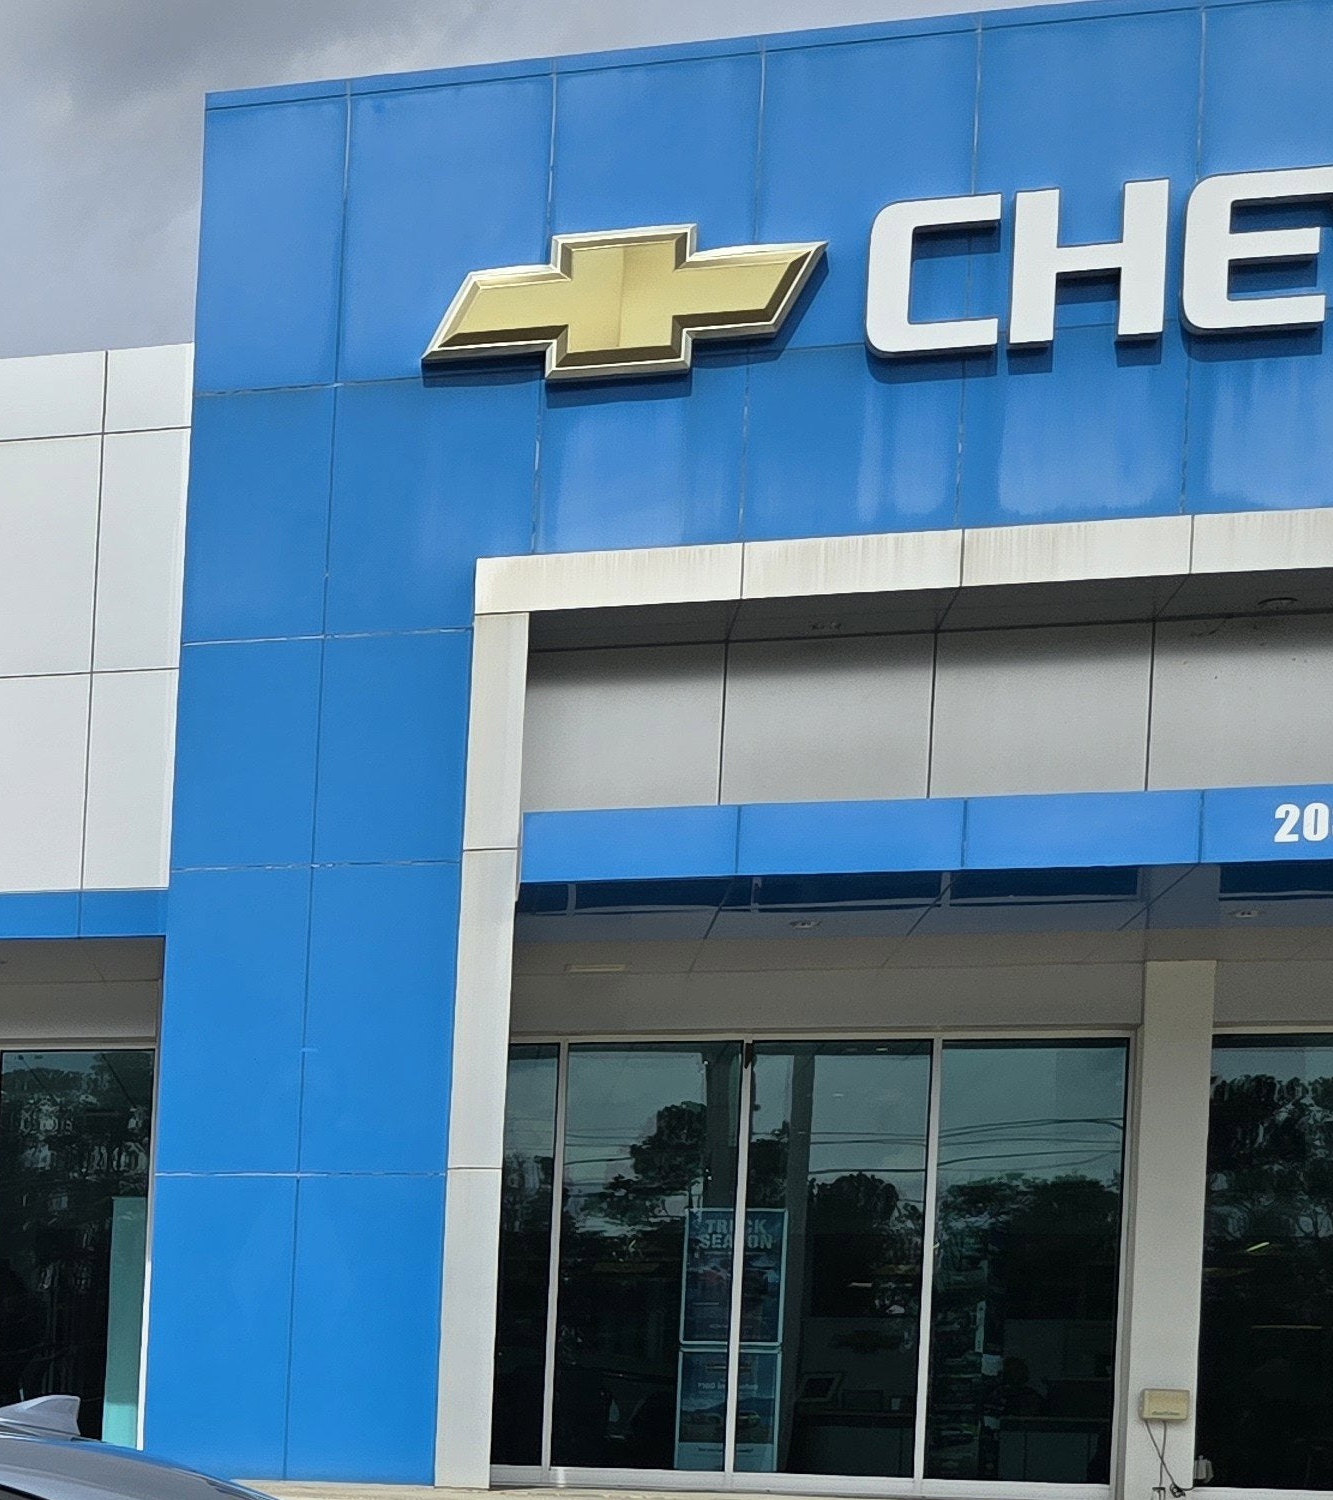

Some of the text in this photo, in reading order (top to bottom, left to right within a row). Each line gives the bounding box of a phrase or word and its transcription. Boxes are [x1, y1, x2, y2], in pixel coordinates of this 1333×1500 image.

[864, 165, 1333, 360] CHE
[1274, 802, 1333, 843] 20
[698, 1233, 773, 1250] SEAON
